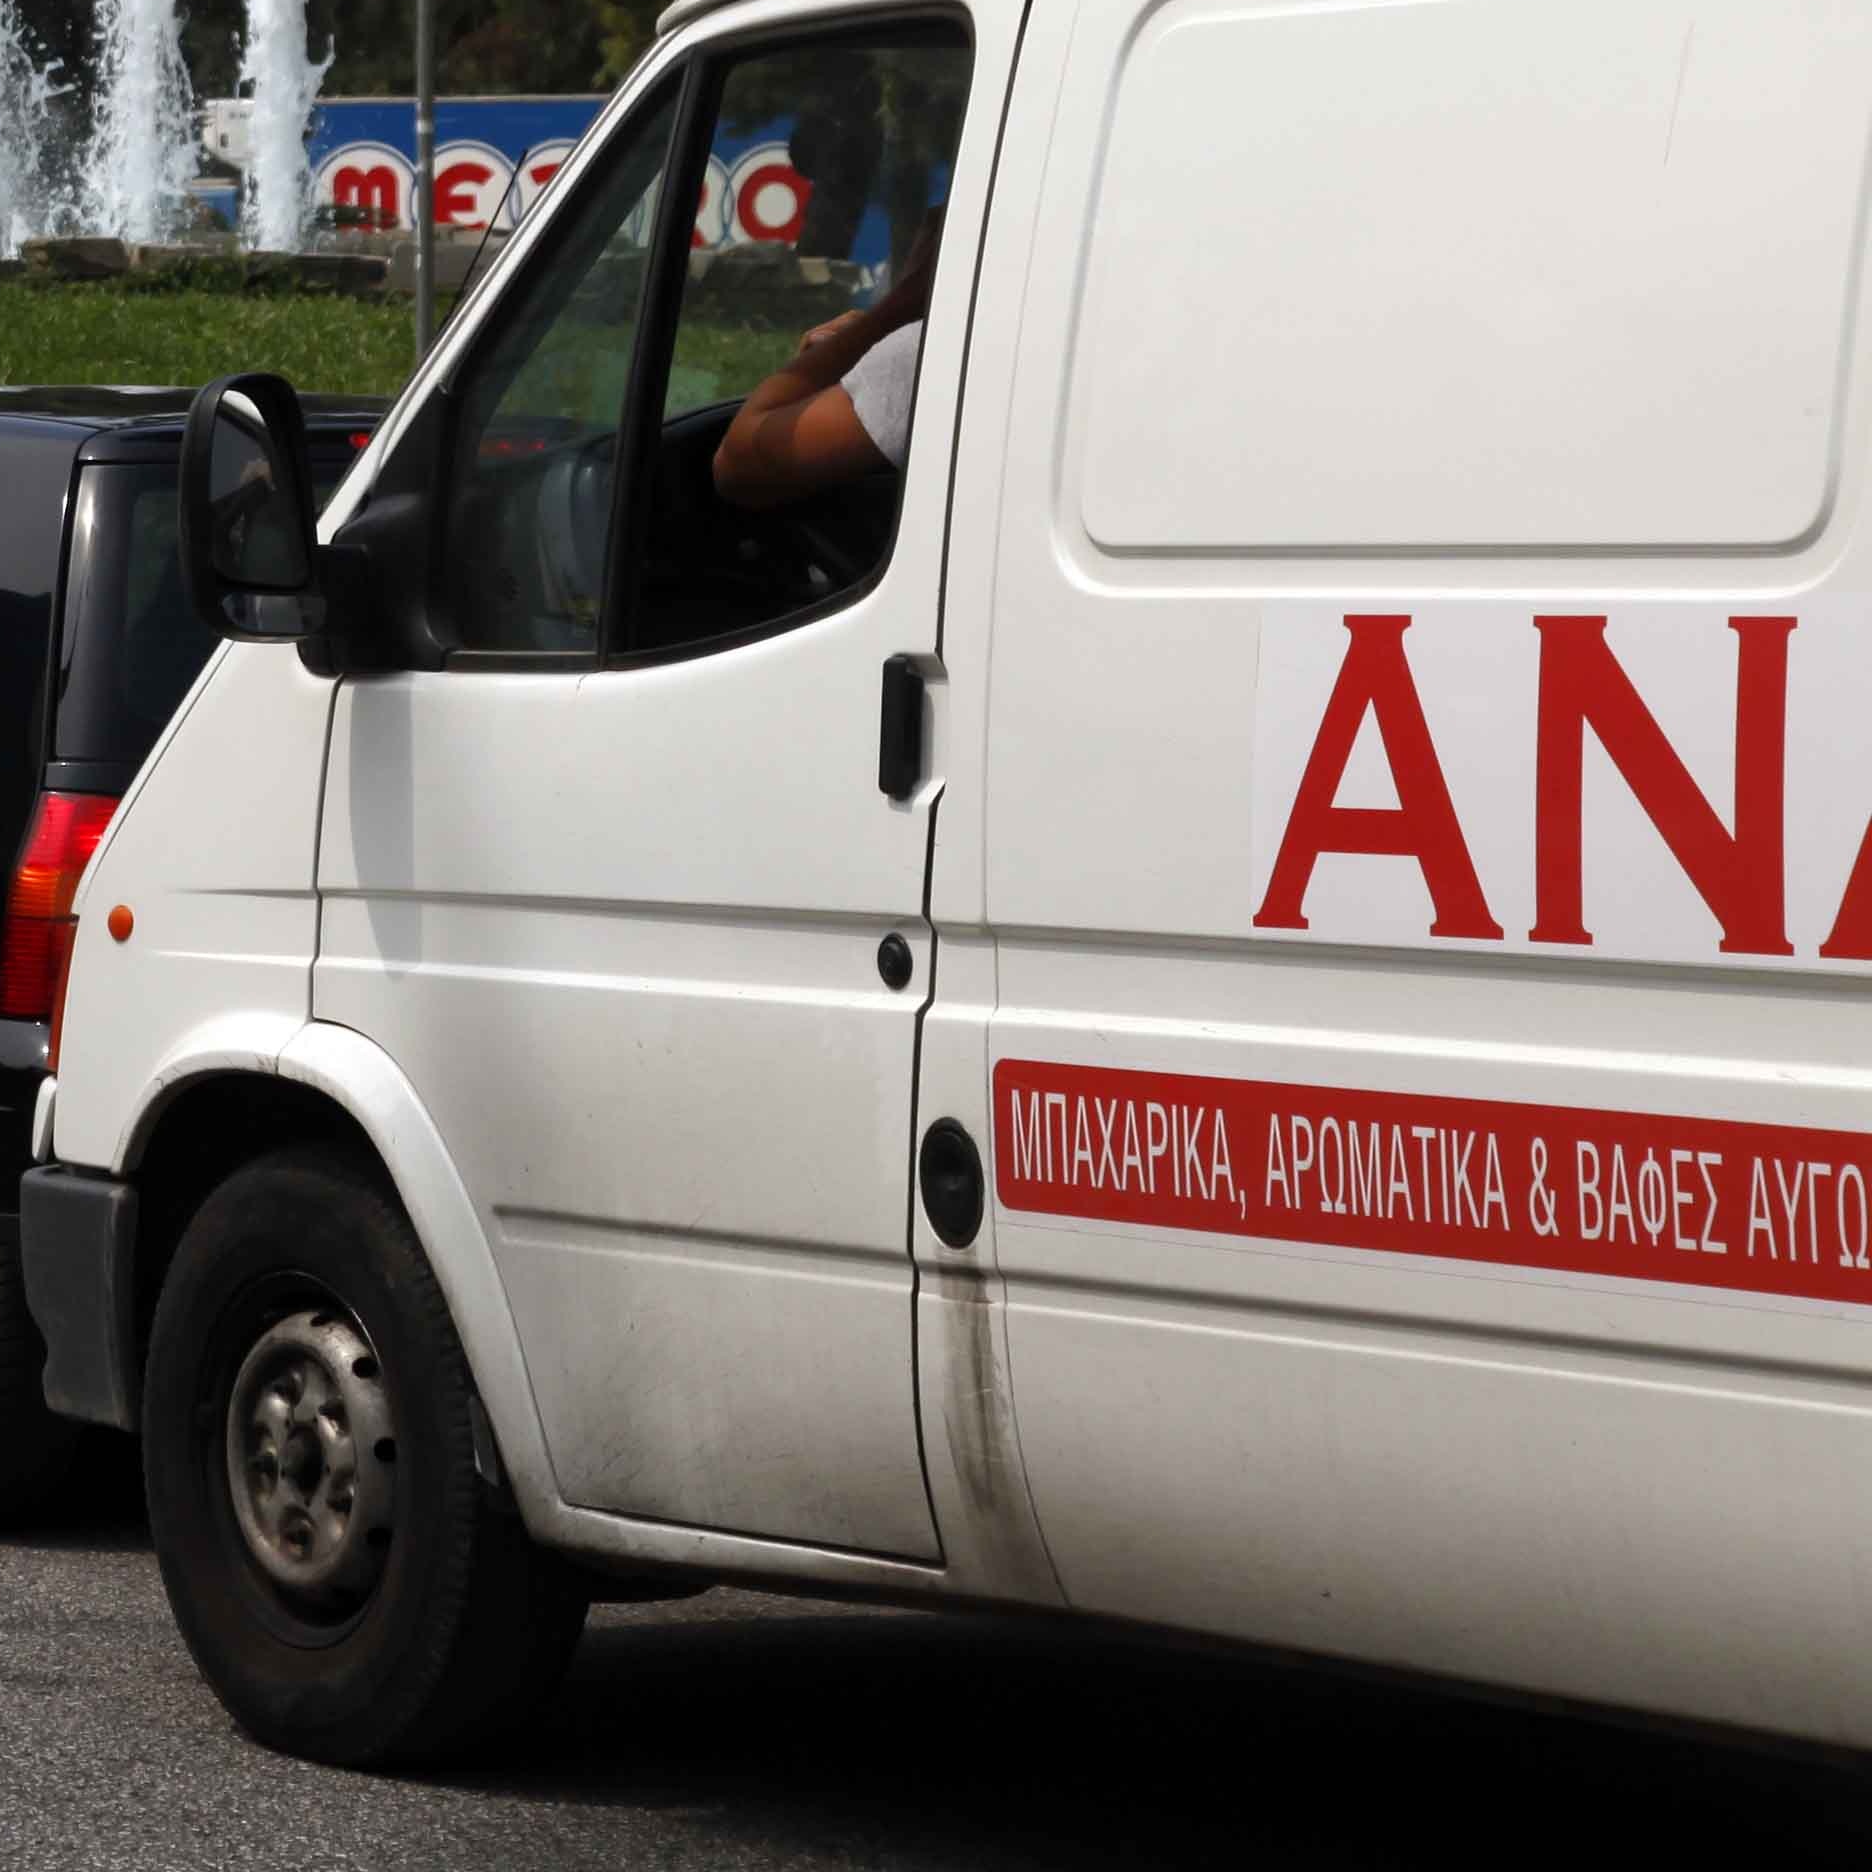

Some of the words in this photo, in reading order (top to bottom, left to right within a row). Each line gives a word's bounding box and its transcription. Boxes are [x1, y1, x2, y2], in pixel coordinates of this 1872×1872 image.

[1010, 1088, 1247, 1220] ΜΠΑΧΑΡΙΚΑ,
[1265, 1111, 1511, 1232] ΑΡΩΜΑΤΙΚΑ
[1528, 1137, 1560, 1237] &
[1576, 1140, 1727, 1254] ΒΑΦΕΣ
